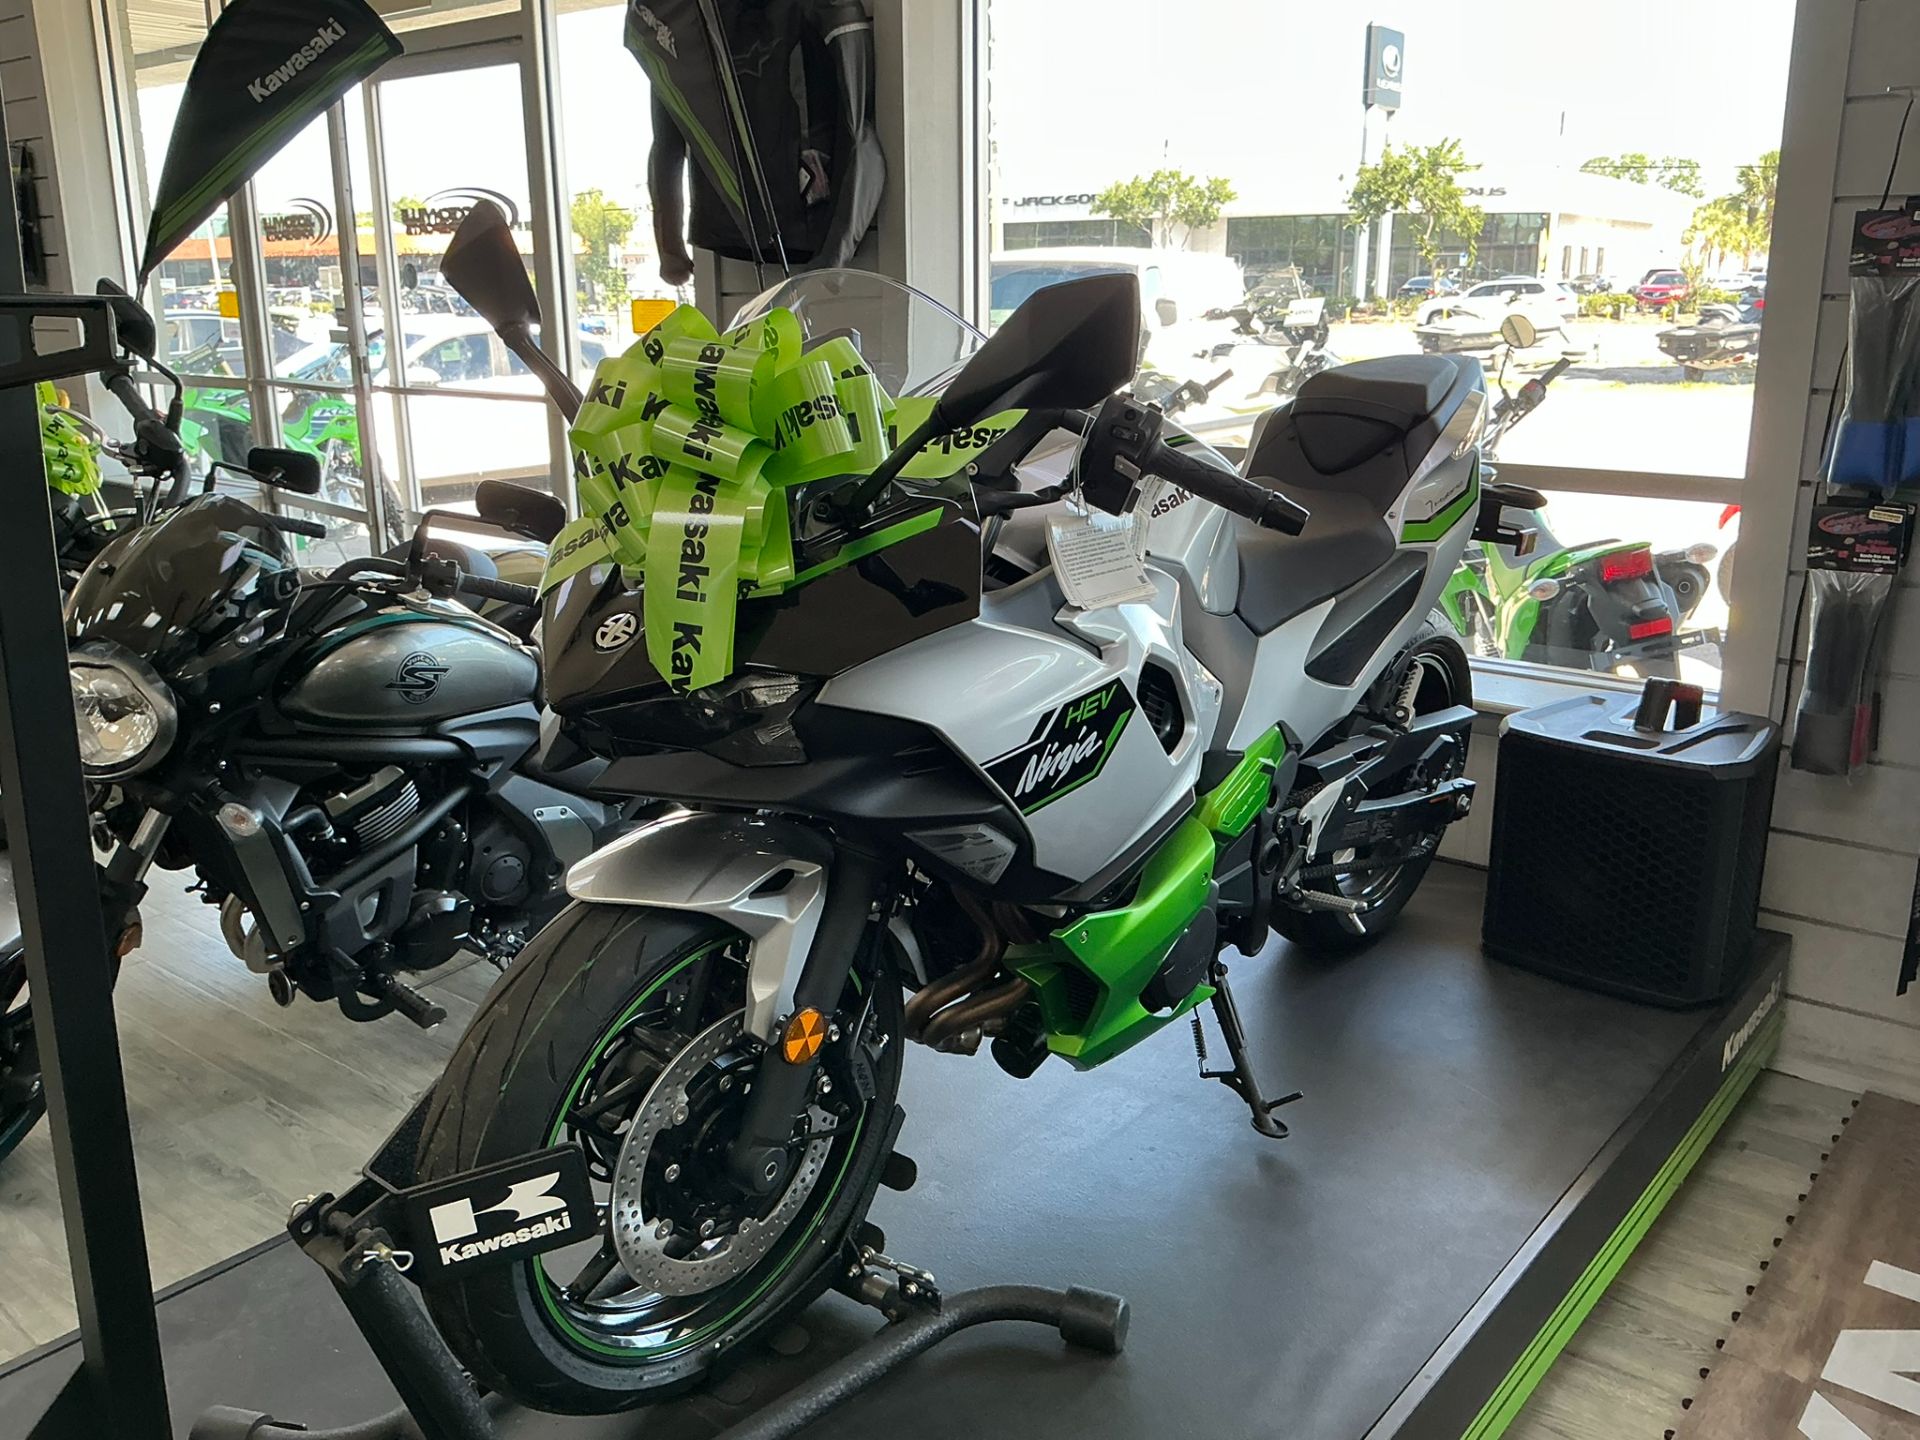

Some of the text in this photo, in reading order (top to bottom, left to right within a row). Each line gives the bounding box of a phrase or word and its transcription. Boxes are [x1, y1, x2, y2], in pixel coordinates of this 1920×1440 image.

[247, 17, 346, 103] Kawasaki
[1064, 684, 1118, 729] HEV
[1014, 725, 1103, 797] Ninja
[439, 1211, 572, 1266] Kawasaki
